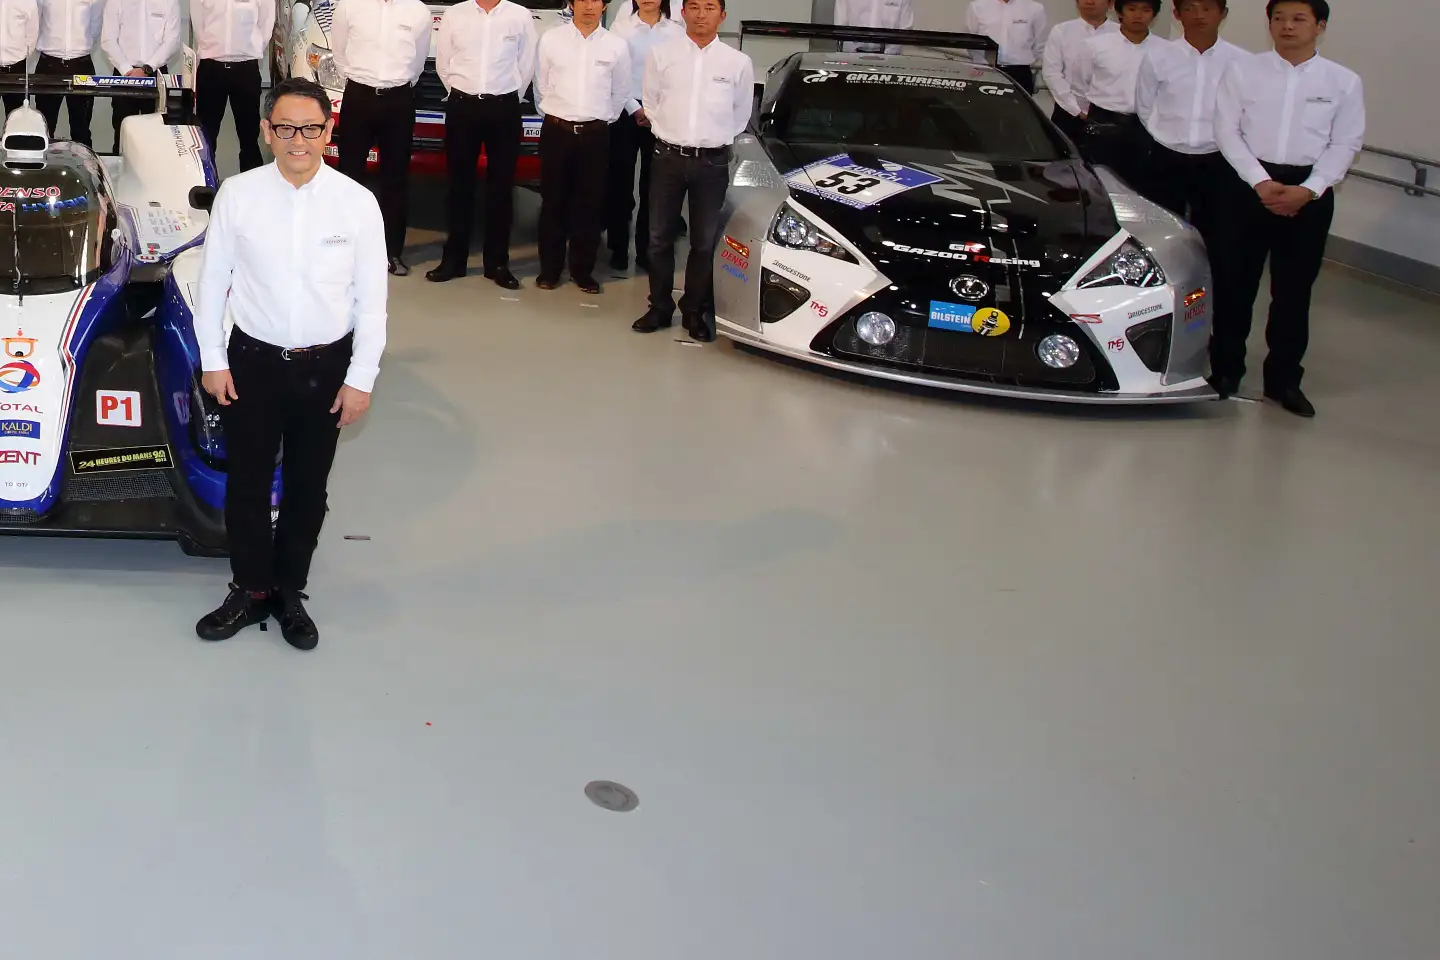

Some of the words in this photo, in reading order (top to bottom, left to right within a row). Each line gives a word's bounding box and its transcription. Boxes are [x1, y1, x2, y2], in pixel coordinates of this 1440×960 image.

[98, 77, 154, 86] MICHELIN
[846, 73, 891, 82] GRAN
[894, 75, 967, 88] TURISMO
[843, 163, 903, 182] ZURICH
[816, 170, 881, 195] 53
[721, 249, 749, 270] DENSO
[893, 244, 968, 260] GAZOO
[973, 255, 1041, 267] Racing
[772, 259, 811, 283] BRIDGESTONE
[931, 311, 971, 325] BILSTEIN
[1127, 303, 1164, 319] BRIDGESTONE
[101, 396, 133, 421] P1
[1, 422, 33, 432] KALDI
[79, 461, 96, 470] 24
[96, 456, 121, 466] HEURES
[122, 454, 132, 462] DU
[133, 451, 152, 460] MANS
